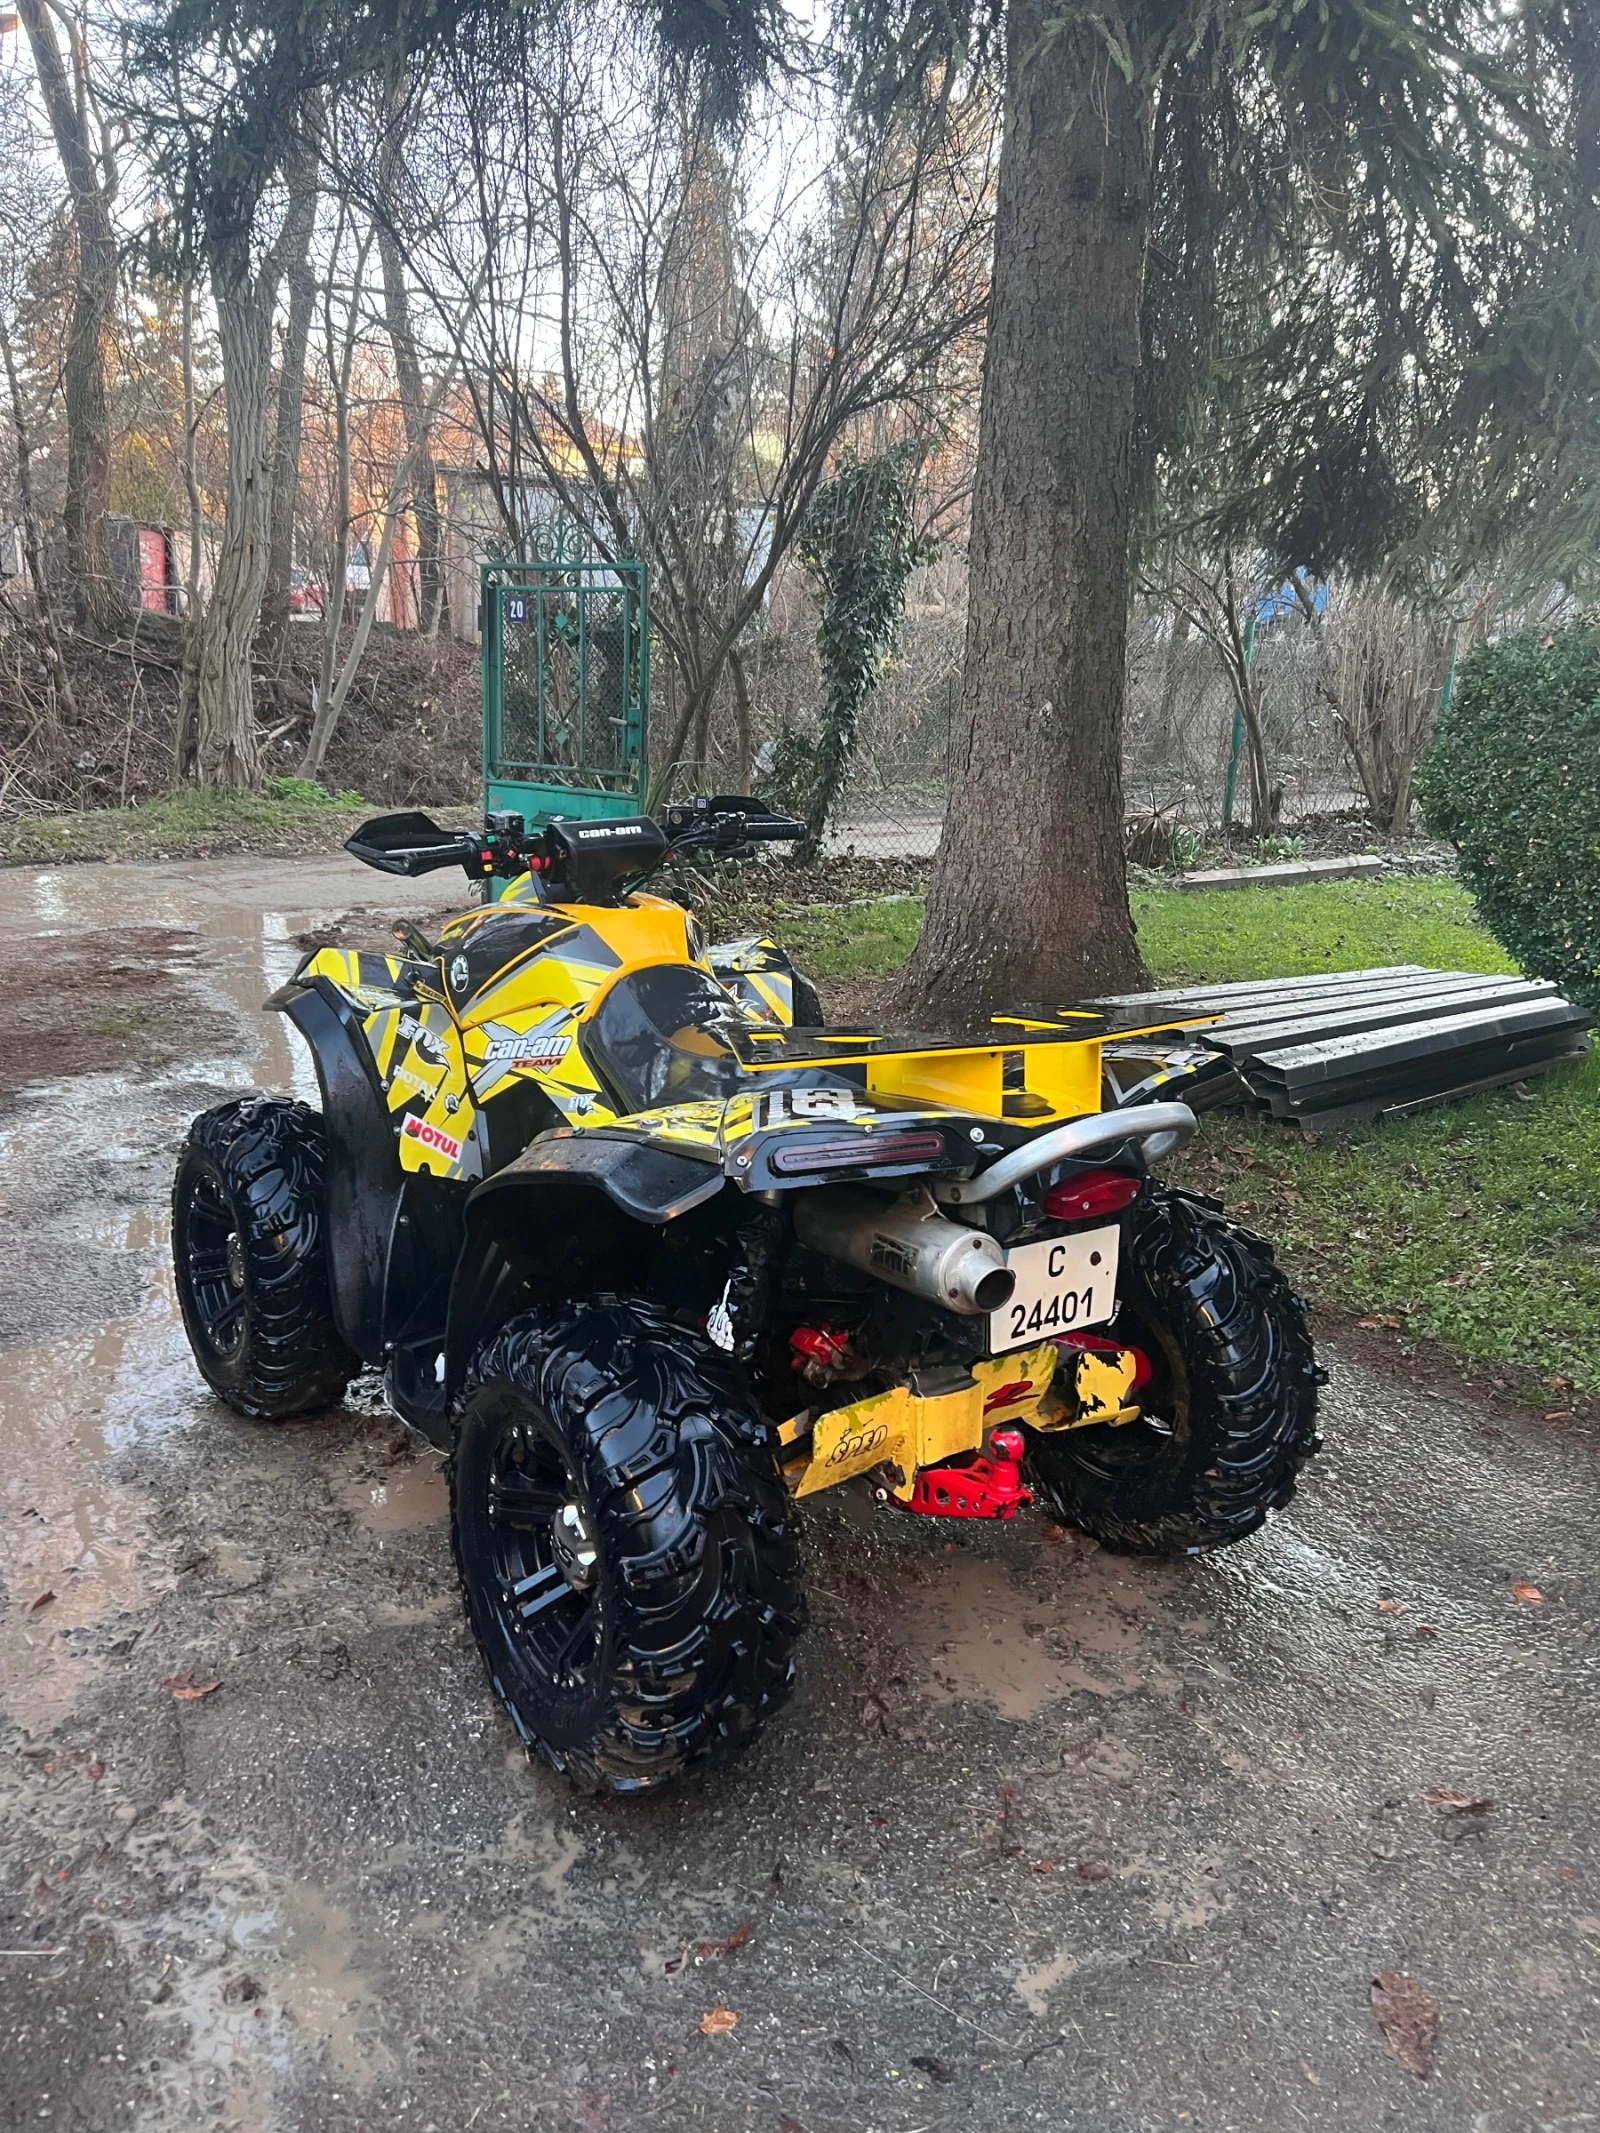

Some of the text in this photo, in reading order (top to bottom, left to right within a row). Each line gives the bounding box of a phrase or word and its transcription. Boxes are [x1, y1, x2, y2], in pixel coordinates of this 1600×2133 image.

[510, 600, 524, 618] 20
[578, 825, 642, 839] can-am
[396, 1013, 450, 1056] FOX
[484, 1035, 573, 1060] can-am
[511, 1057, 565, 1069] TEAM
[393, 1064, 438, 1102] ROTAX
[568, 1093, 597, 1110] FOX
[405, 1118, 459, 1159] MOTUL
[1048, 1245, 1066, 1277] C
[1010, 1287, 1093, 1339] 24401
